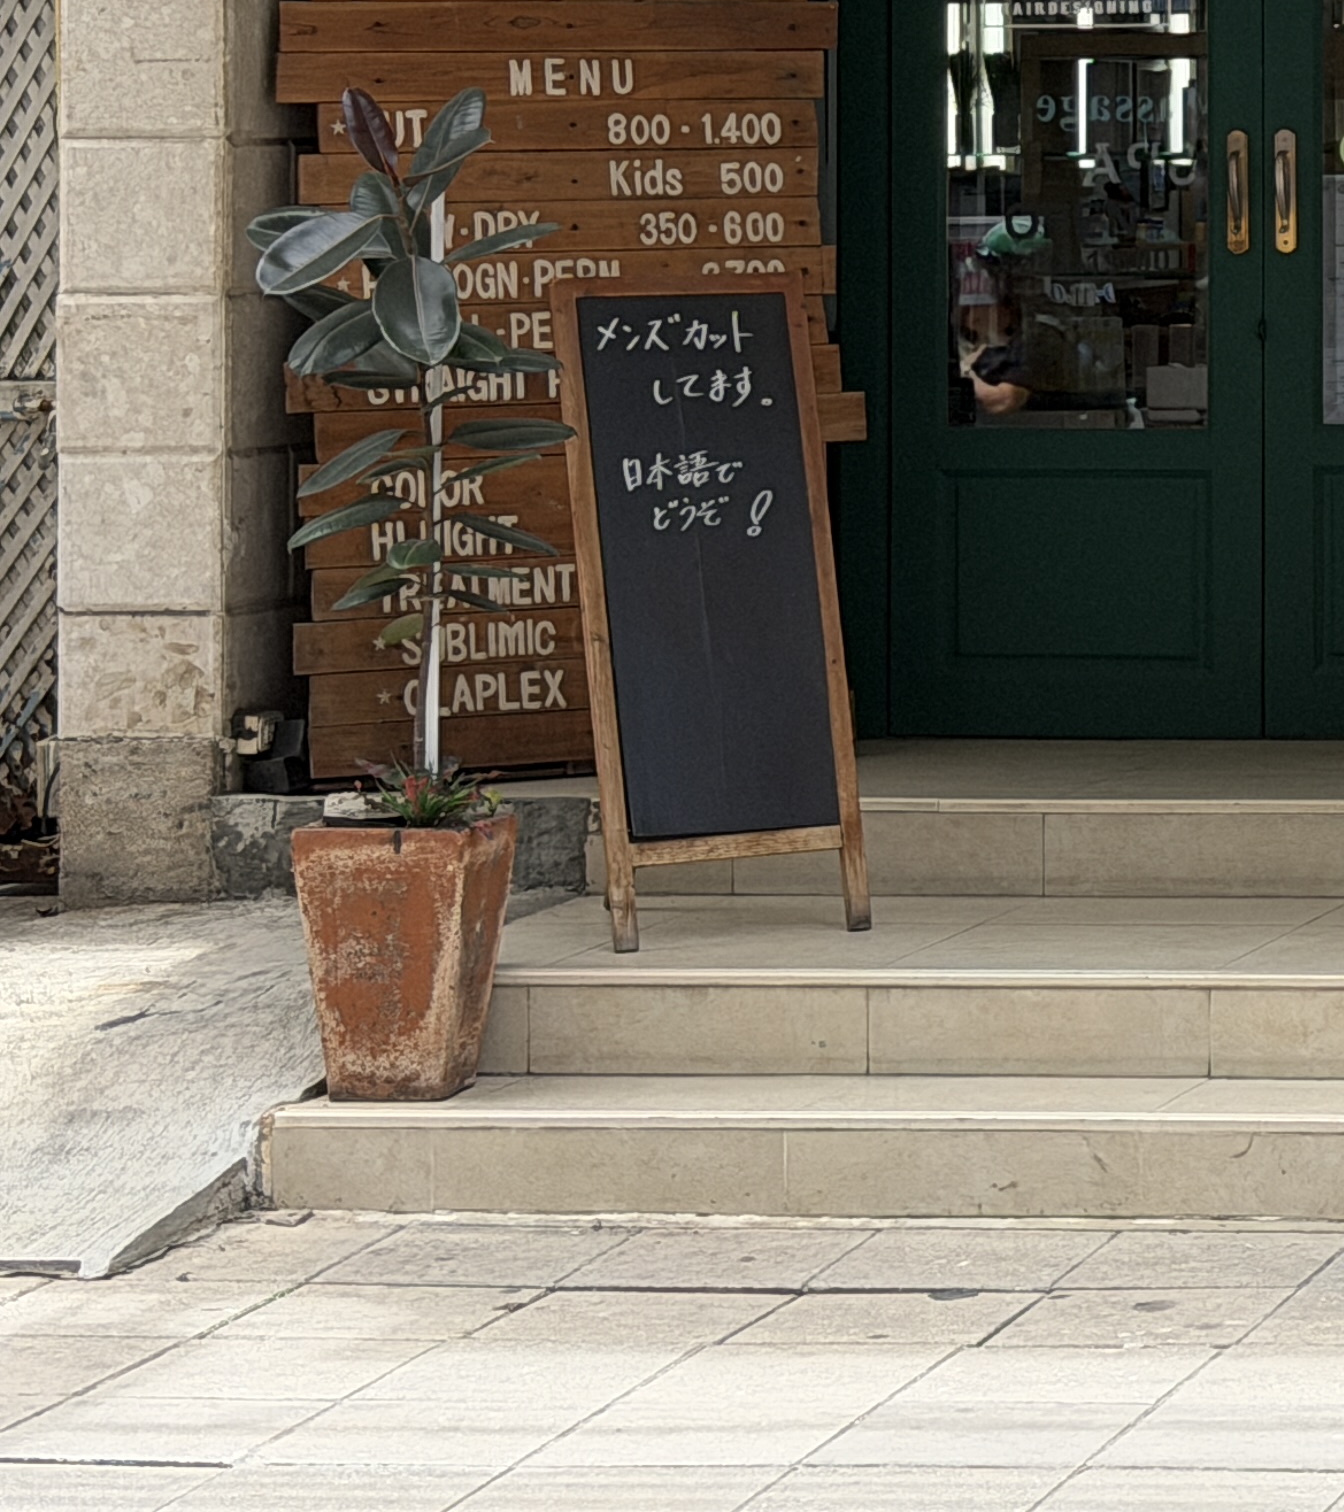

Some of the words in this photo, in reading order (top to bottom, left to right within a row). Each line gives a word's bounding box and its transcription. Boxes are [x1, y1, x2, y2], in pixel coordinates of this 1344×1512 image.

[1002, 0, 1153, 16] AIRDESIGNING
[509, 58, 634, 96] MENU
[607, 112, 671, 146] 800
[701, 112, 782, 146] 1.400
[609, 159, 684, 196] Kids
[720, 161, 784, 195] 500
[639, 211, 698, 246] 350
[723, 210, 785, 245] 600
[653, 366, 774, 408] してます。
[621, 449, 744, 492] 日本語で
[403, 669, 568, 717] OAPLEX
